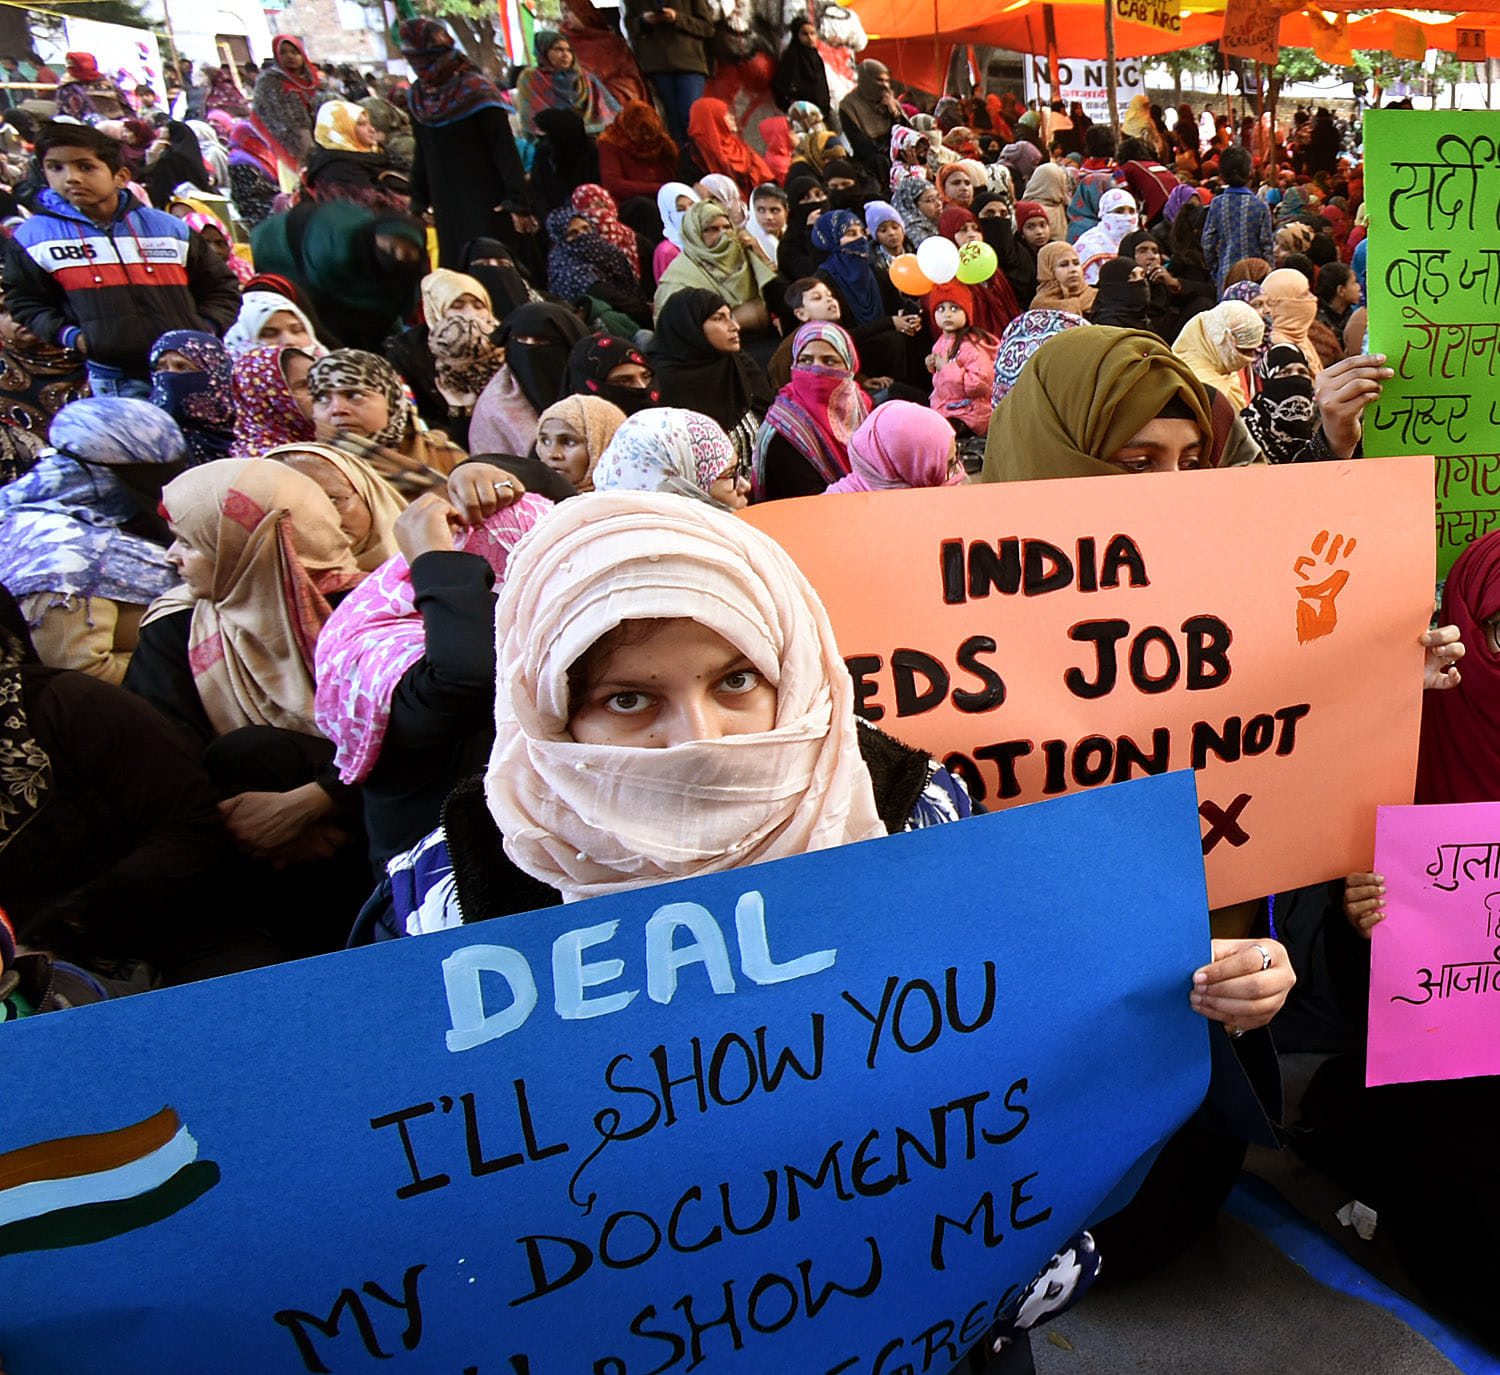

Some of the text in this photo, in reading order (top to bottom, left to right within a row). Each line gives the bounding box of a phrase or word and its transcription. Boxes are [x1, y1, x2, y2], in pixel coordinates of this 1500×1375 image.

[1153, 10, 1181, 32] NRC
[1033, 61, 1072, 85] NO
[50, 244, 97, 260] 086
[940, 534, 1150, 605] INDIA
[1064, 614, 1233, 699] JOB
[1192, 703, 1310, 770] NOT
[1199, 793, 1252, 855] X
[440, 890, 837, 1052] DEAL
[371, 960, 996, 1216] I'LL SHOW YOU
[273, 1078, 1029, 1373] MY DOCUMENTS
[593, 1172, 1053, 1375] SHOW ME
